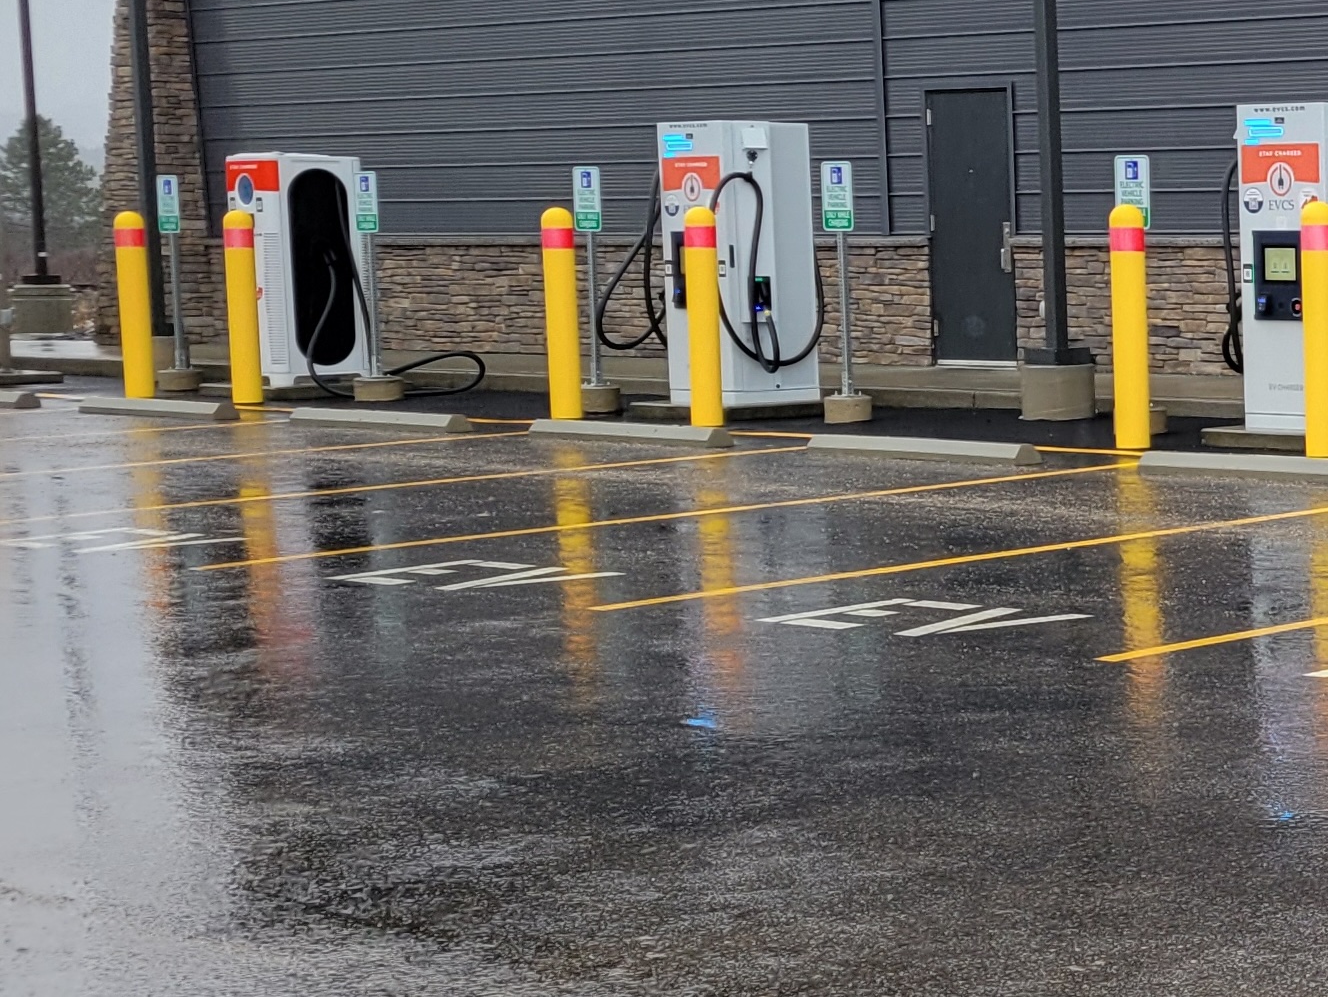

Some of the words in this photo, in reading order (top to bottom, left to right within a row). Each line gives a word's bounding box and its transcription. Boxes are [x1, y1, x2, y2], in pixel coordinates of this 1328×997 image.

[1268, 199, 1295, 211] EVCS
[324, 559, 627, 591] EV
[754, 598, 1095, 637] EV
